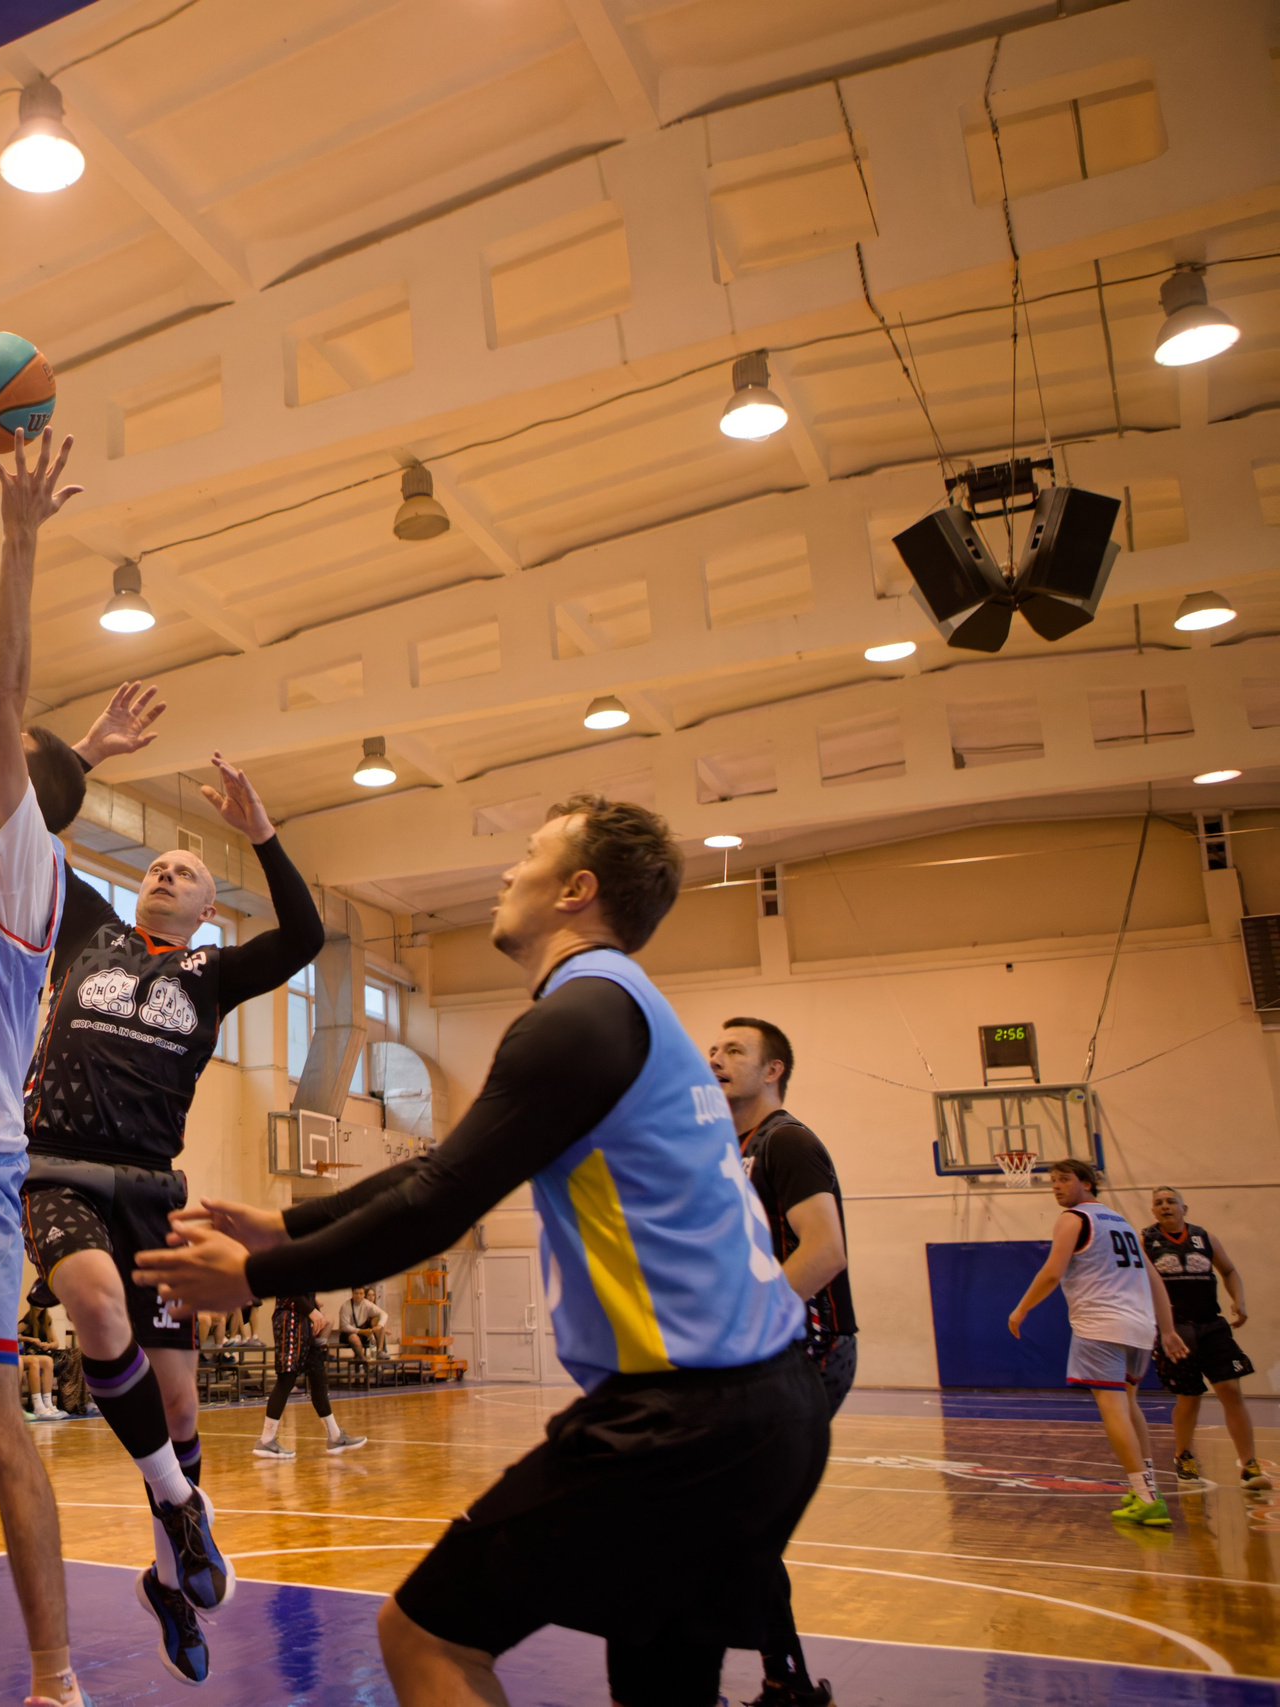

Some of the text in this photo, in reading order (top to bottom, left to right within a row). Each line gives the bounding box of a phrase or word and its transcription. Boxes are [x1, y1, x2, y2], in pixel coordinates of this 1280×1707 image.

[118, 1026, 129, 1037] IN
[129, 1031, 154, 1043] GOOD
[994, 1027, 1025, 1041] 2:56
[1110, 1230, 1144, 1268] 99
[1191, 1235, 1205, 1249] 91
